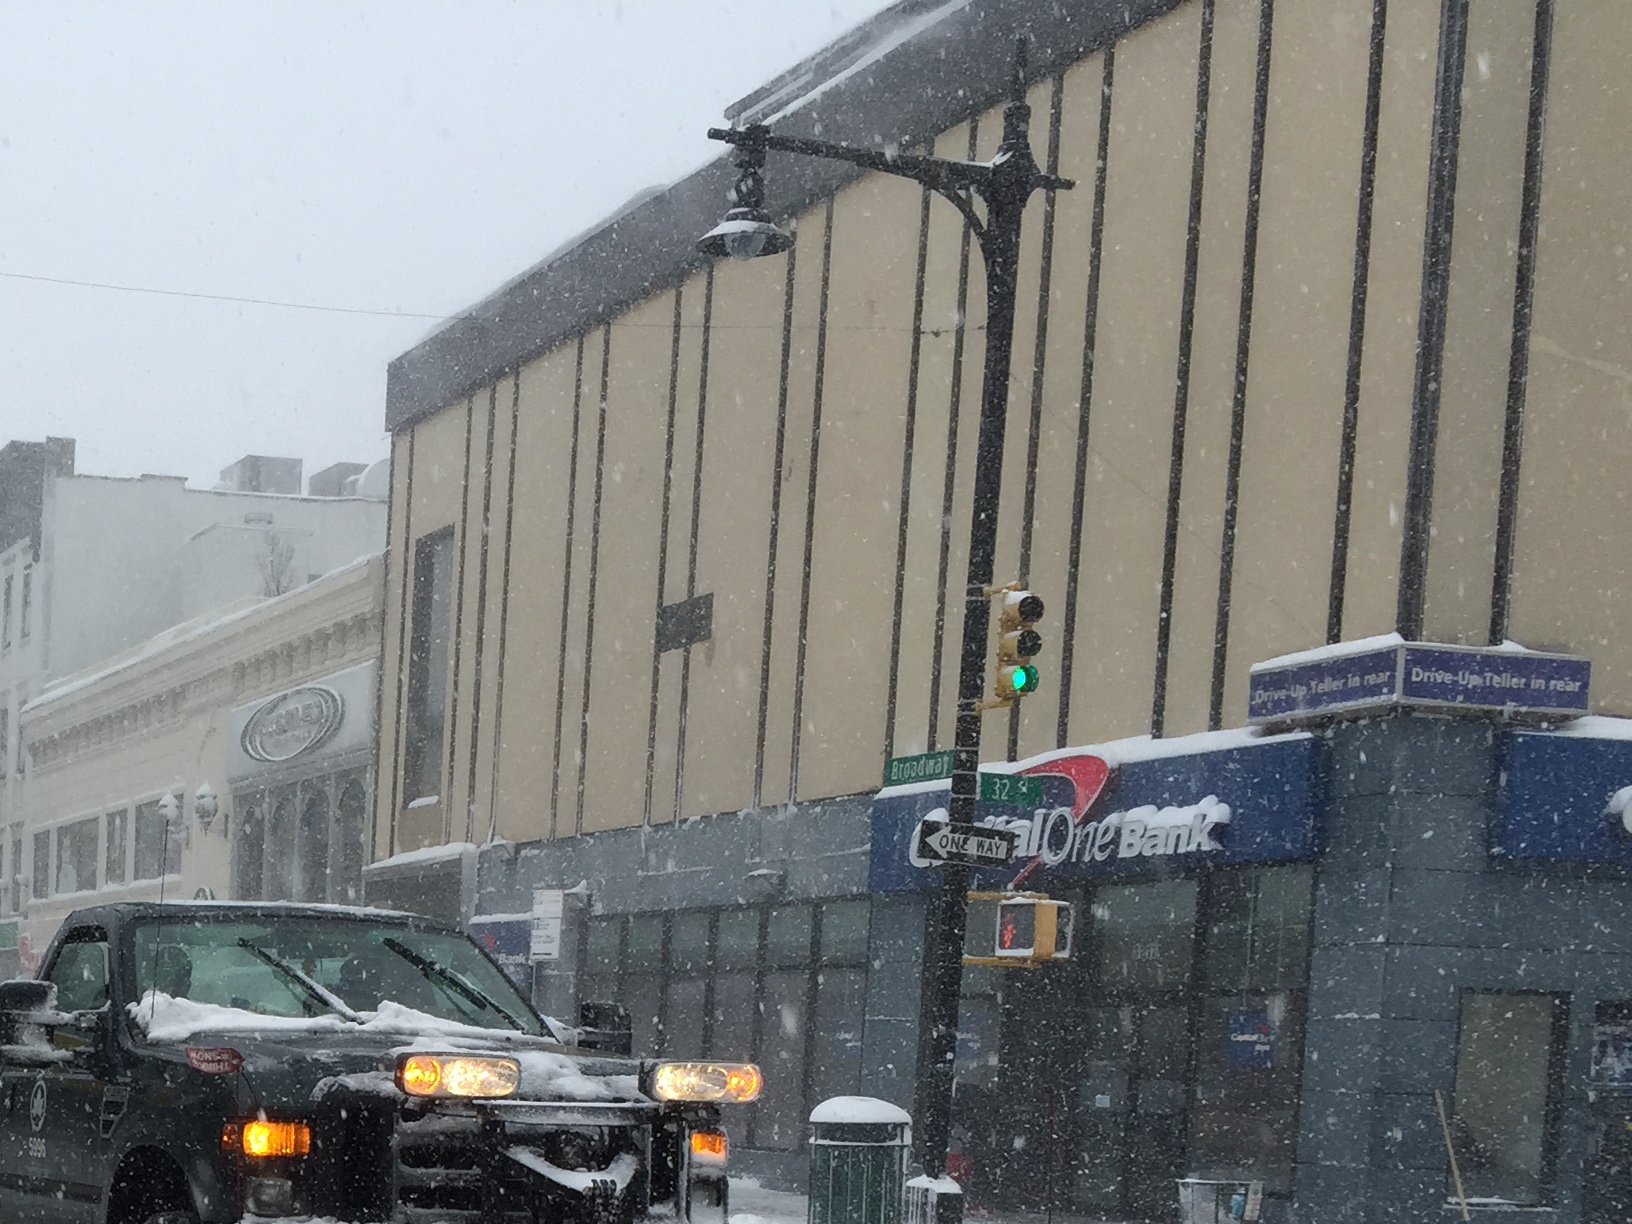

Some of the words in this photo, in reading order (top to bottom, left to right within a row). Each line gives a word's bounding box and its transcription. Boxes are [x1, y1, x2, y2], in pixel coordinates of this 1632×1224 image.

[1347, 675, 1360, 689] in
[1363, 672, 1391, 686] rear
[1411, 667, 1480, 690] Drive-Up
[1484, 674, 1525, 690] Teller
[1531, 677, 1546, 691] in
[1549, 679, 1582, 693] rear
[890, 754, 950, 781] Broadway
[992, 778, 1011, 800] 32
[939, 834, 969, 851] ONE
[976, 838, 1003, 856] WAY
[1118, 812, 1225, 859] Bank
